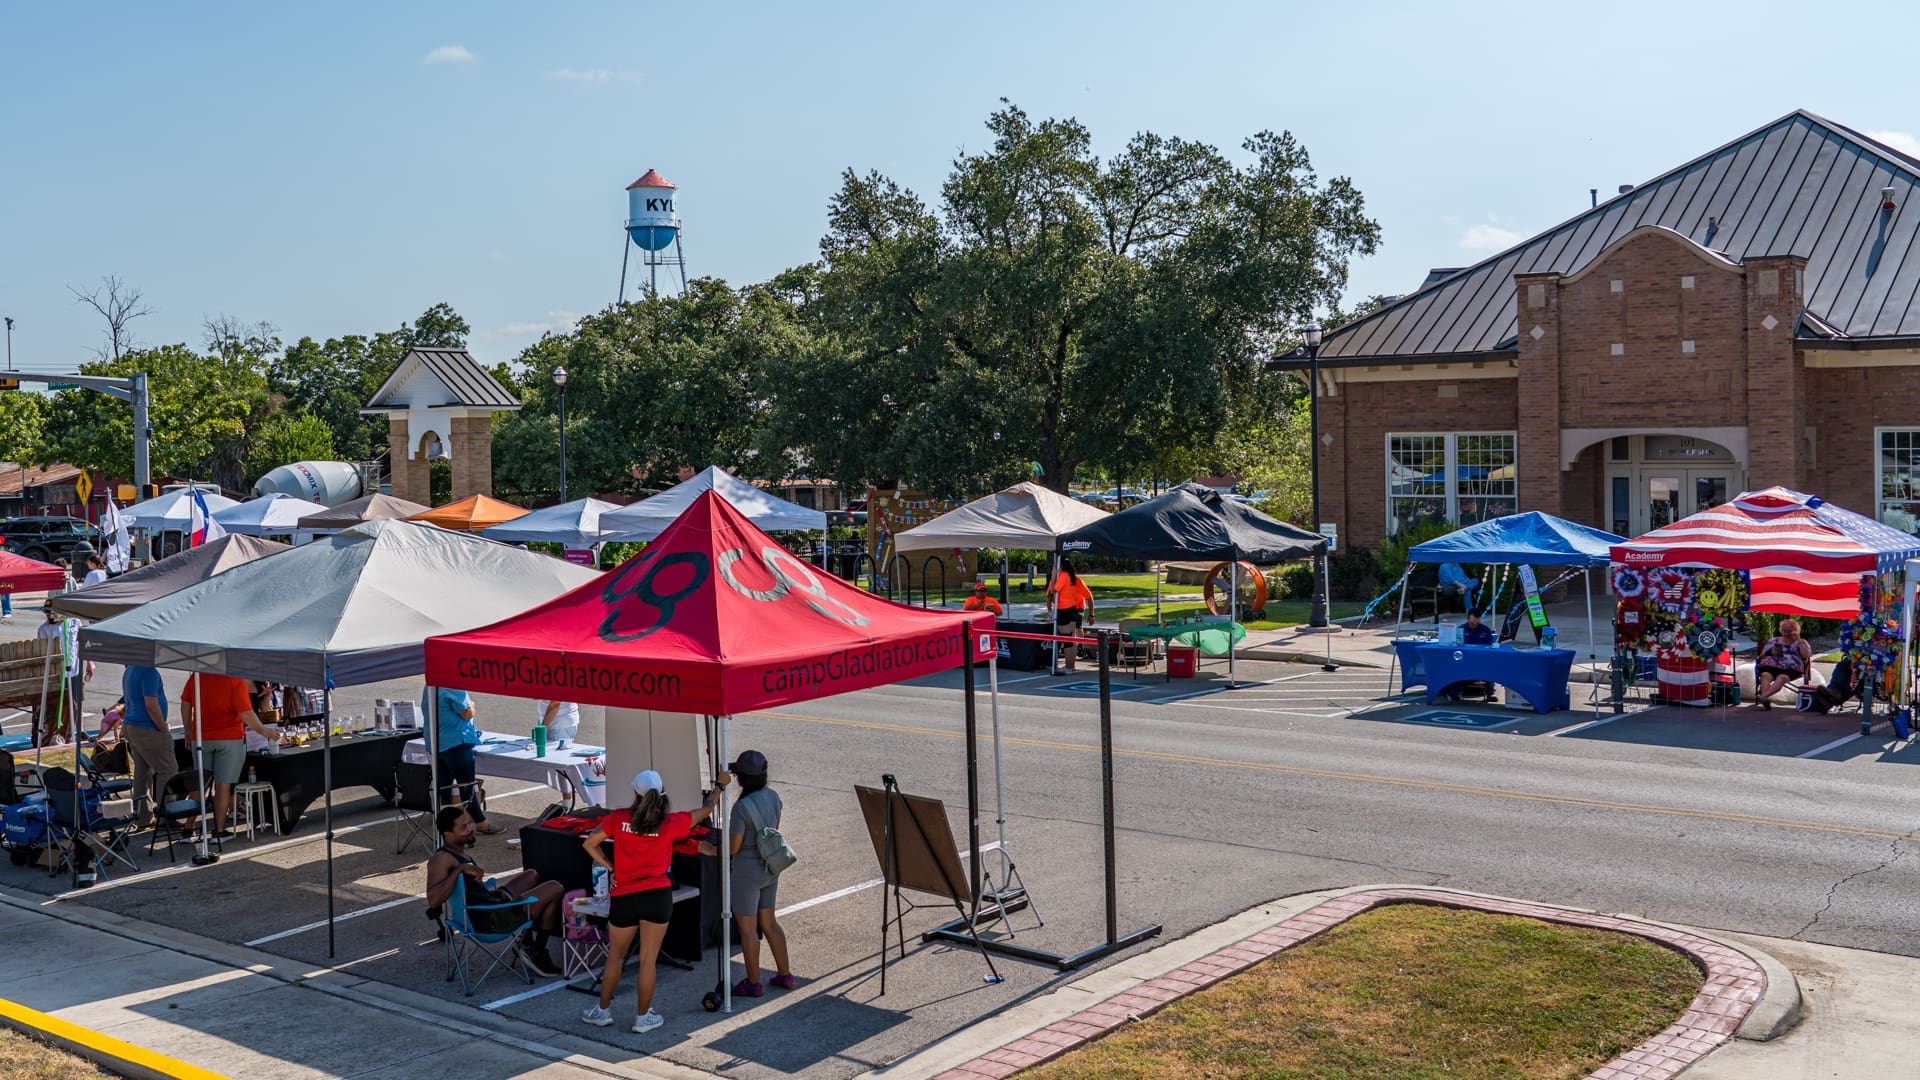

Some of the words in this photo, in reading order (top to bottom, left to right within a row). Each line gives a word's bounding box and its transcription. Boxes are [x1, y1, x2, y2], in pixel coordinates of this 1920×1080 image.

[1625, 552, 1665, 560] Academy
[457, 655, 682, 697] campGladiator.com
[762, 632, 965, 693] campGladiator.com
